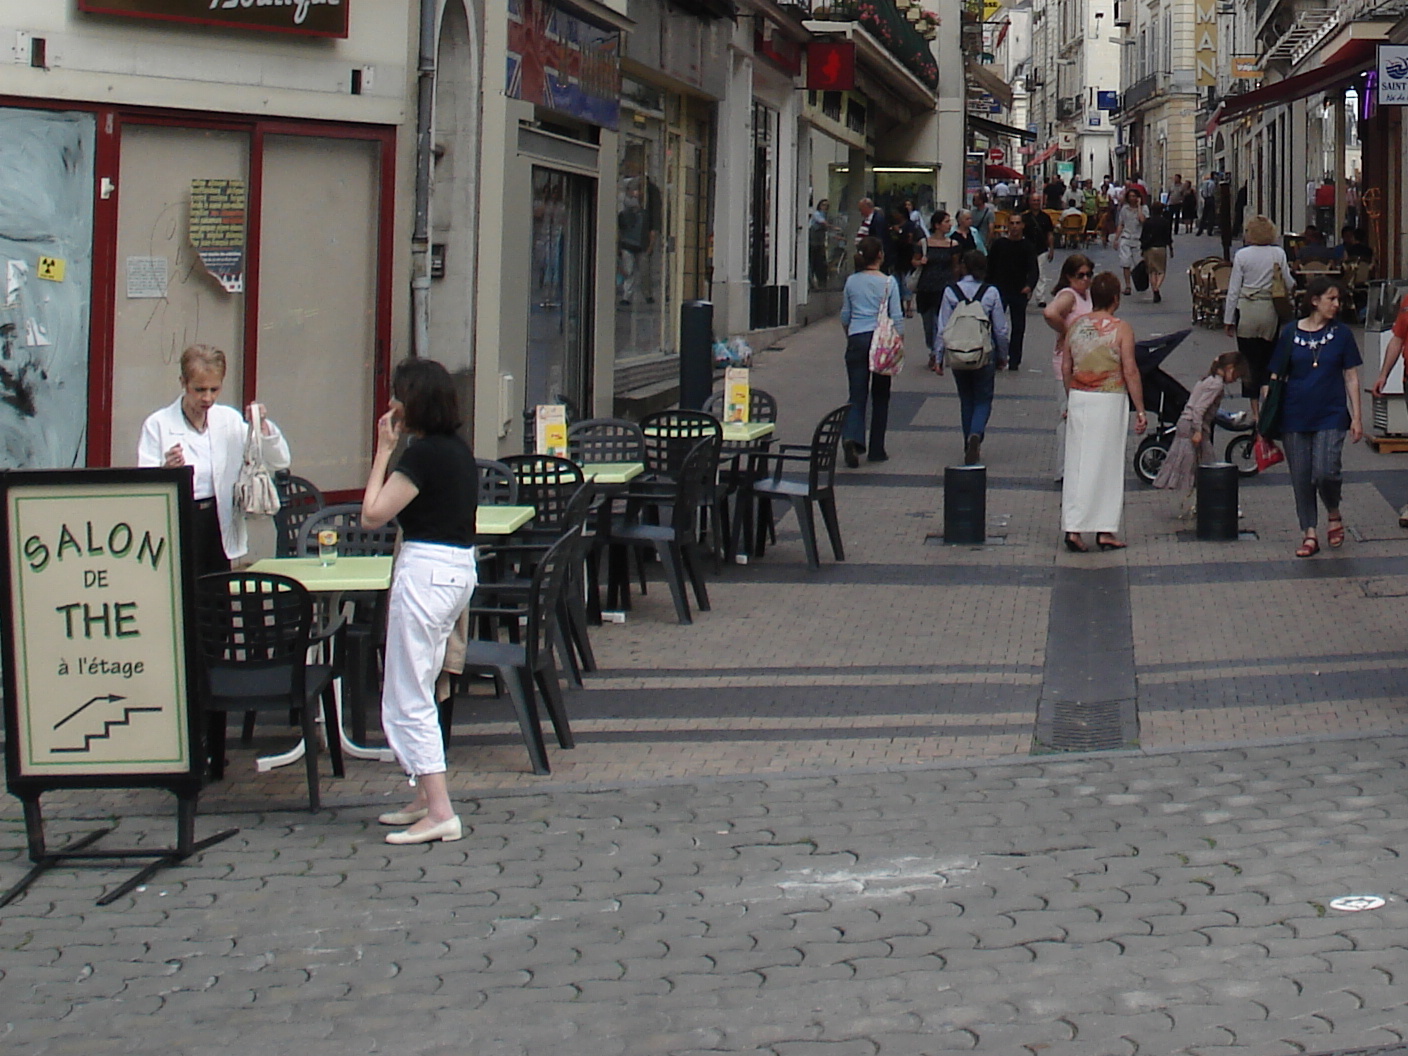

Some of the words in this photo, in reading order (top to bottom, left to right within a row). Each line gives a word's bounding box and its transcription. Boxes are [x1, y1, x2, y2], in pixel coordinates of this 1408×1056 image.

[1196, 3, 1217, 81] MAN
[1381, 81, 1407, 91] SAINT
[24, 520, 166, 574] SALON
[83, 569, 109, 589] DE
[55, 601, 142, 640] THE
[57, 657, 69, 676] à
[78, 656, 145, 679] l'étage
